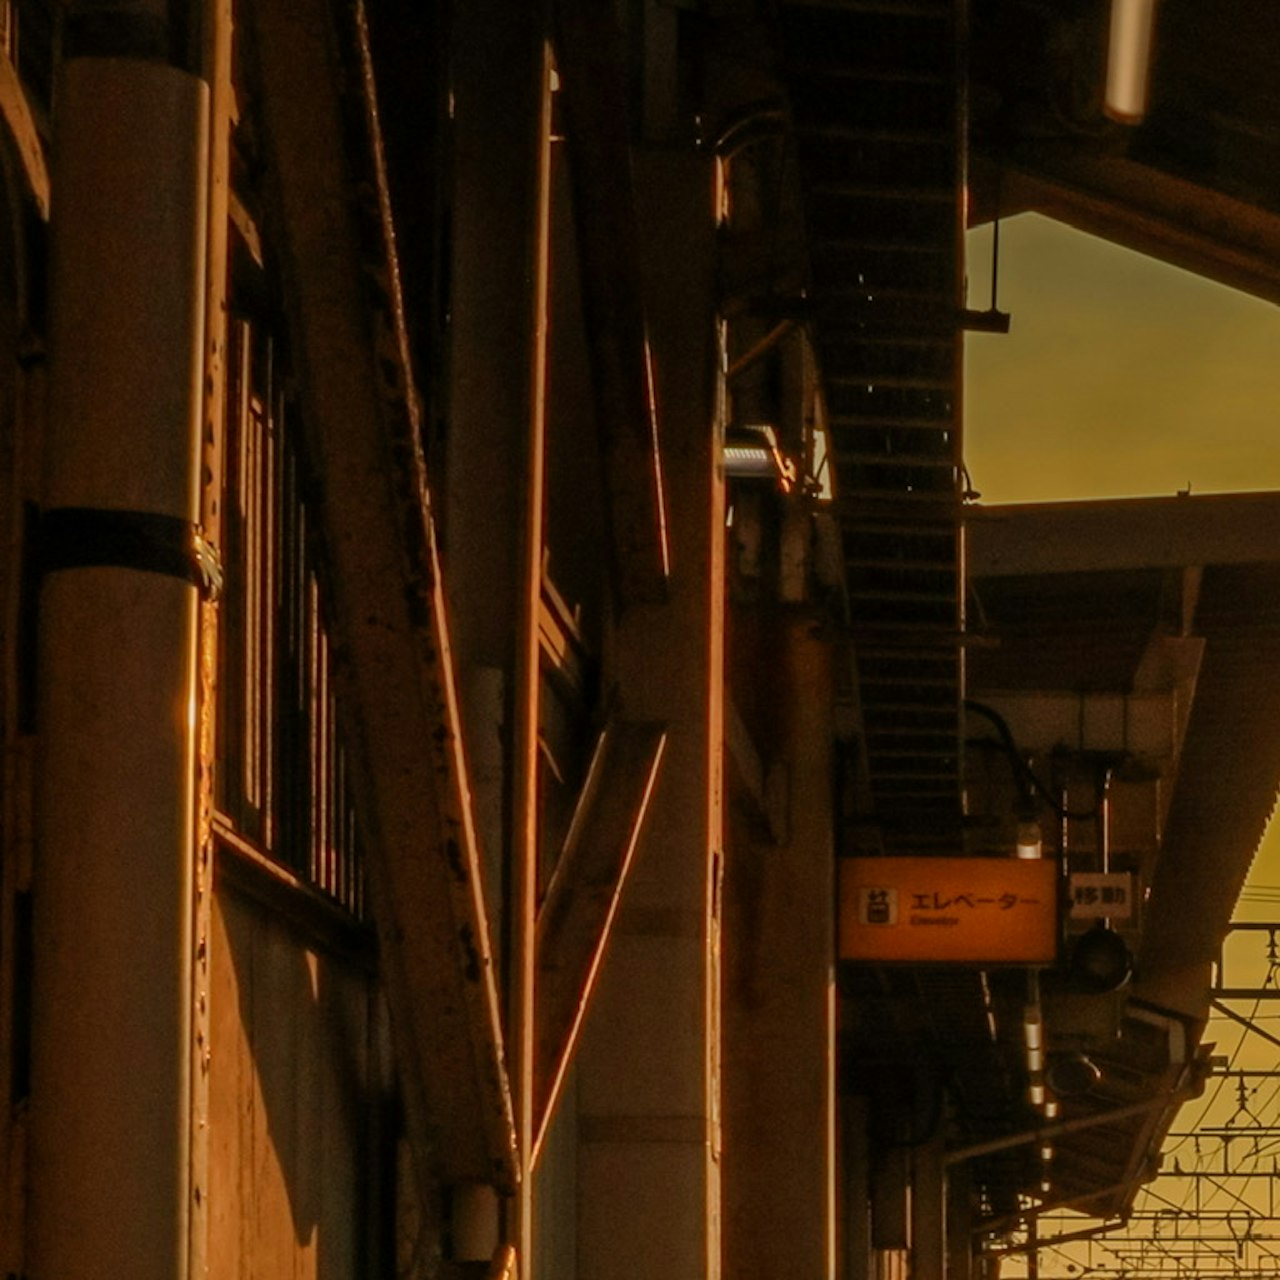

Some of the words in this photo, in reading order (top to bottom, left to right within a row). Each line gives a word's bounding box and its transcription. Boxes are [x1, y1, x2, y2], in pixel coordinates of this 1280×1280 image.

[911, 892, 1040, 911] エレベーター
